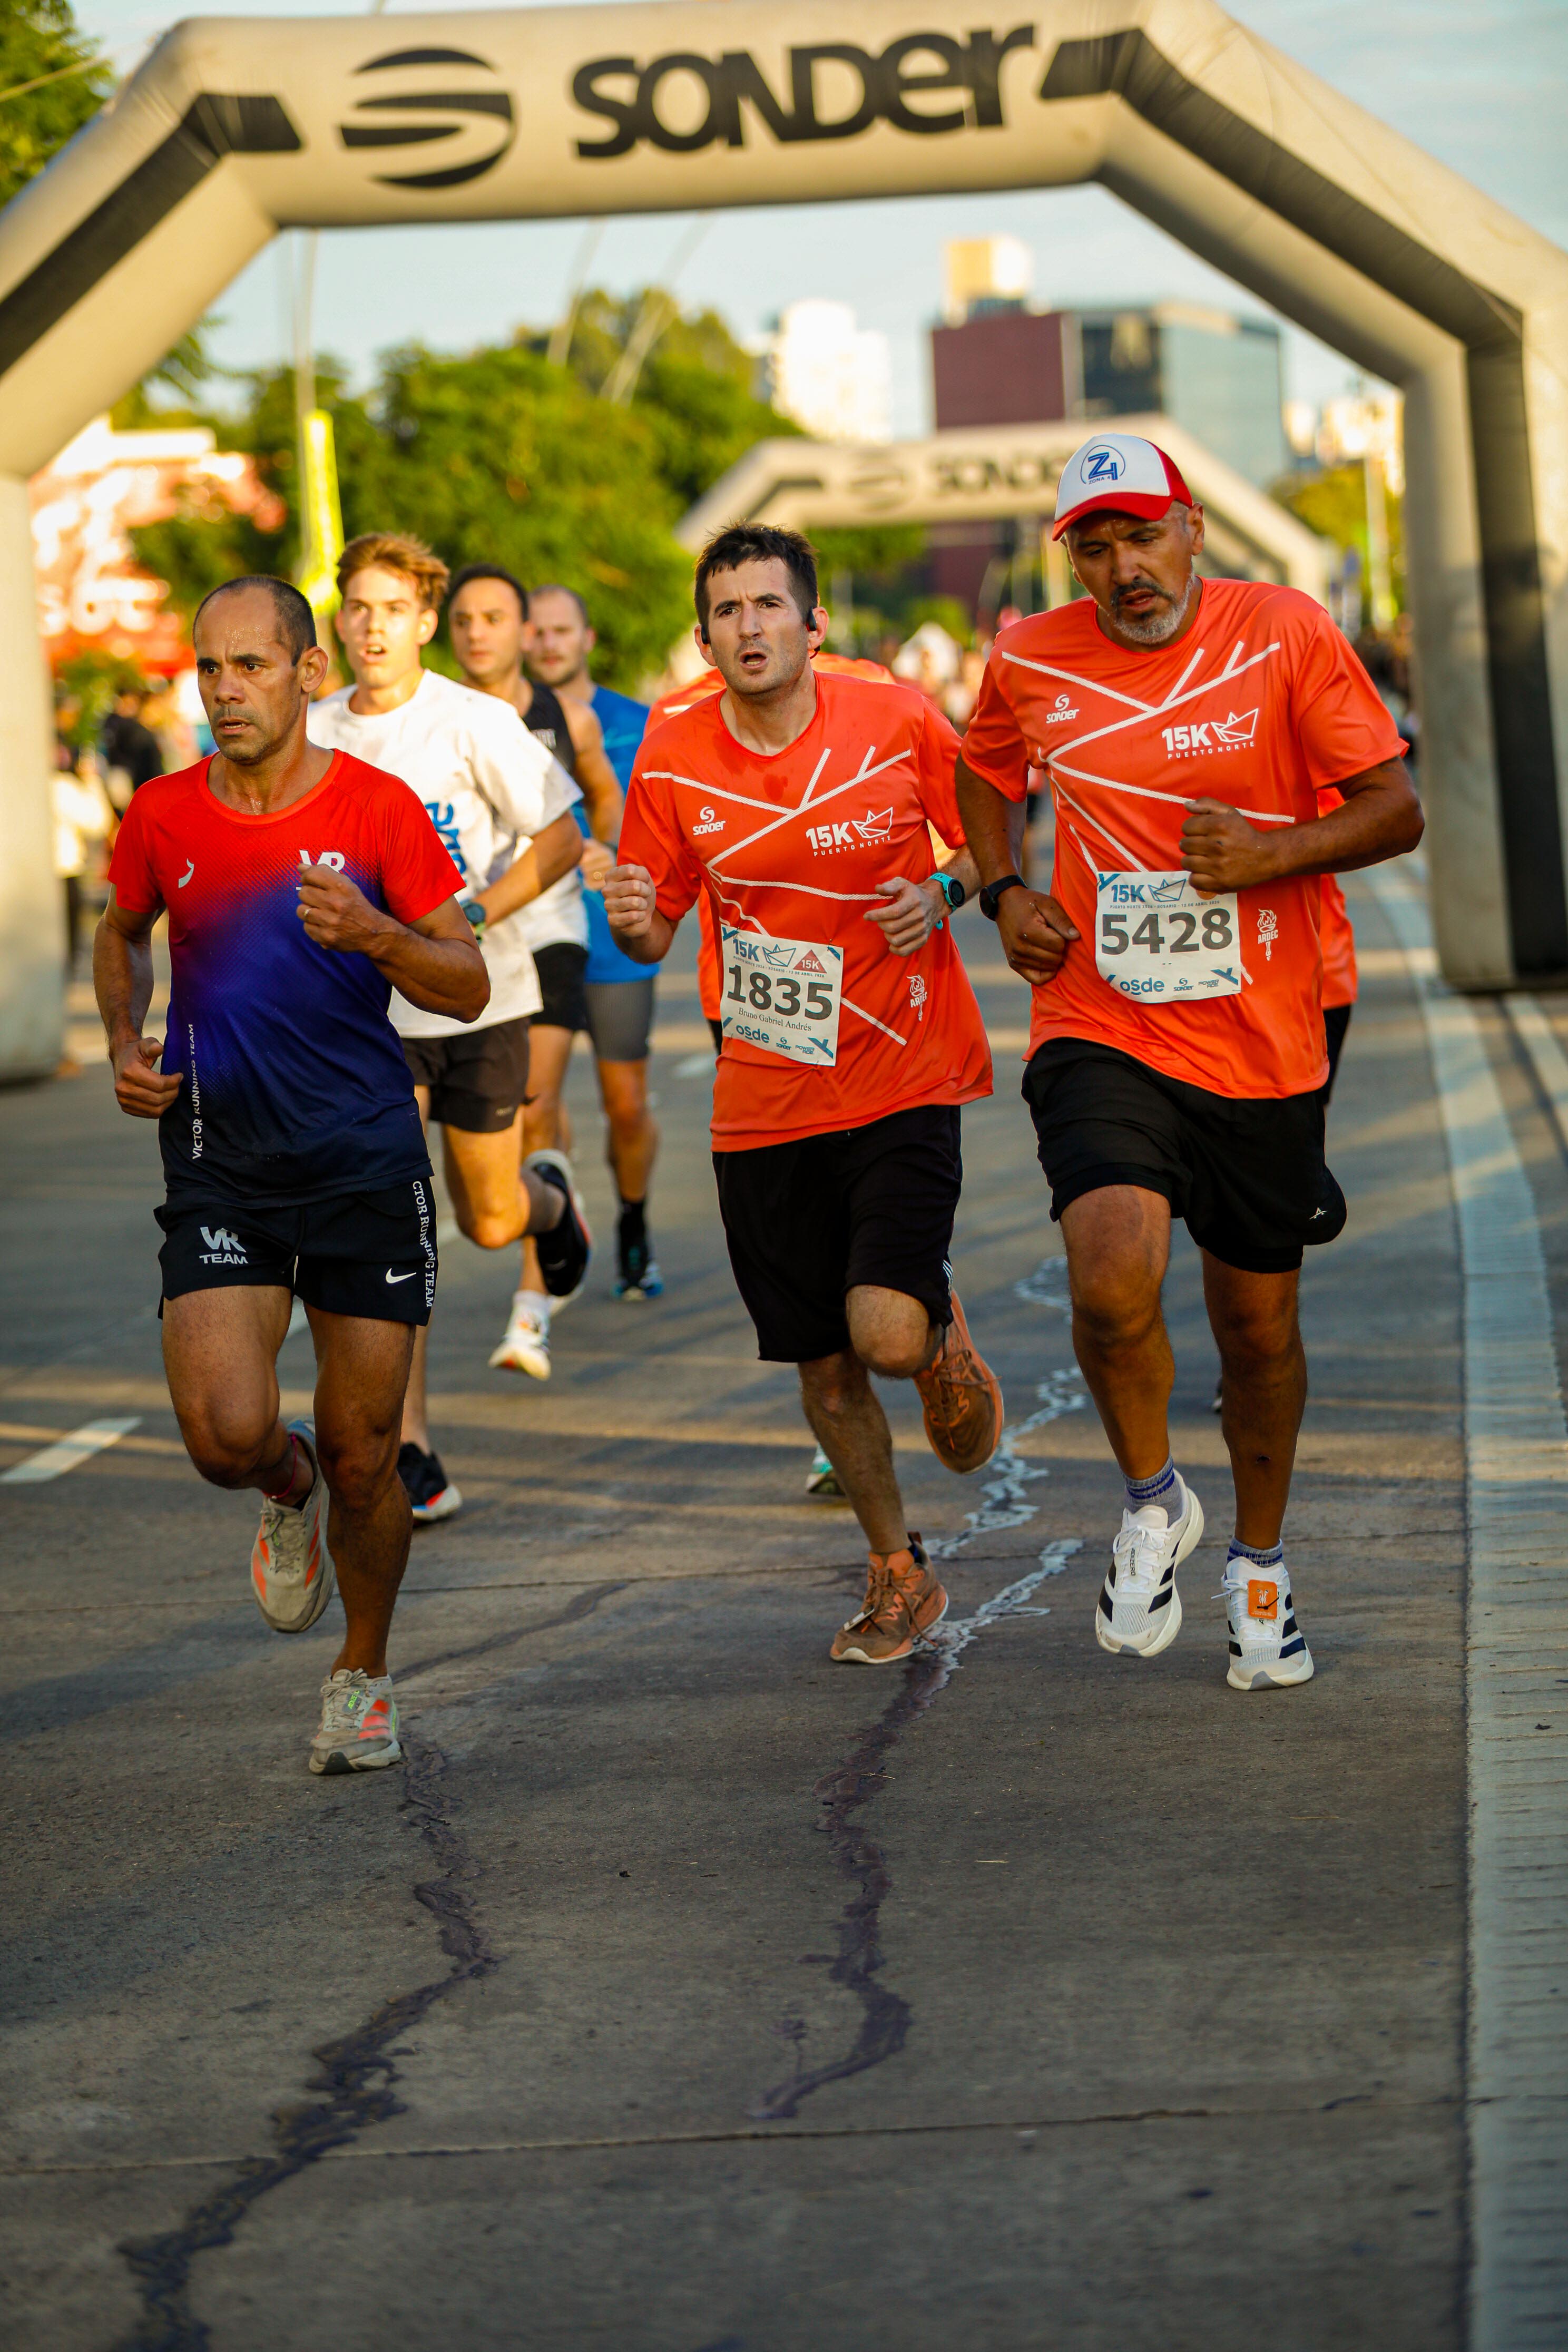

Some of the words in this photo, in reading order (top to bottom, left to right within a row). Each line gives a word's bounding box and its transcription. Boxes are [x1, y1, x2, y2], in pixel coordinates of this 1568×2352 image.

[1162, 723, 1212, 751] 15K
[1168, 748, 1213, 759] PUERTO
[1218, 741, 1255, 752] NORTE
[806, 821, 854, 849] 15K
[814, 845, 855, 857] PUERTO
[860, 835, 891, 848] NORTE
[1111, 884, 1145, 903] 15K
[1101, 908, 1233, 955] 5428
[733, 938, 760, 962] 15K
[801, 959, 819, 970] 15K
[727, 964, 834, 1021] 1835
[1120, 977, 1165, 995] osde
[739, 1007, 758, 1020] Bruno
[759, 1014, 783, 1026] Gabriel
[785, 1021, 812, 1032] Andrés
[736, 1024, 770, 1043] osde
[191, 1060, 200, 1114] RUNNING
[192, 1119, 203, 1159] VICTOR
[413, 1181, 427, 1215] CTOR
[420, 1216, 436, 1269] RUNNING
[199, 1253, 249, 1265] TEAM
[425, 1271, 435, 1307] TEAM
